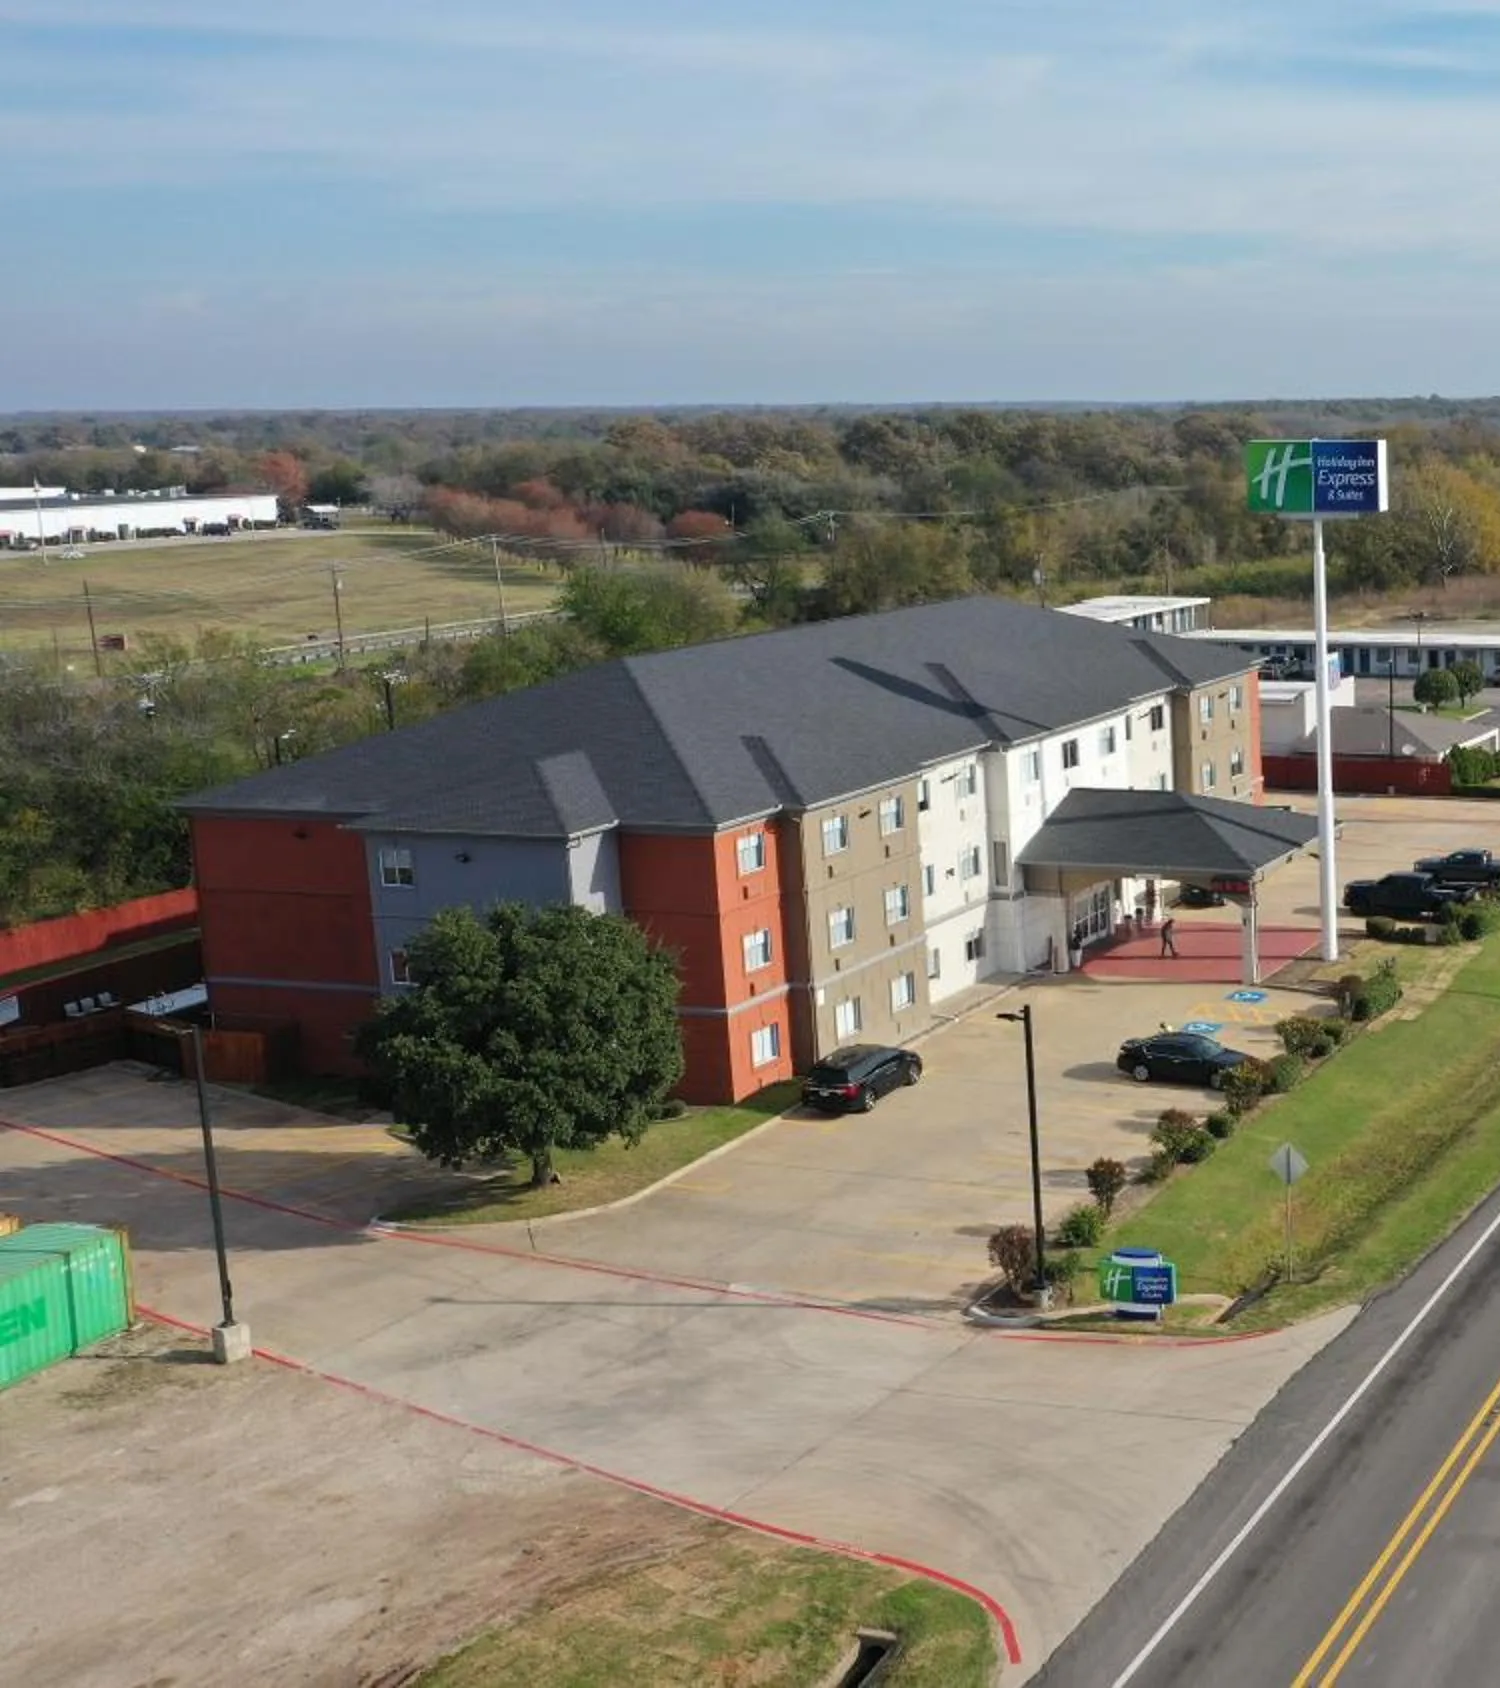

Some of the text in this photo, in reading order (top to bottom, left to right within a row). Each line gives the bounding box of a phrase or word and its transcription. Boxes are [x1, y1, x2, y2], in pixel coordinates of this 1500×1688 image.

[1317, 456, 1375, 470] Holiday Inn
[1317, 469, 1375, 488] Express
[1336, 489, 1363, 501] Suites
